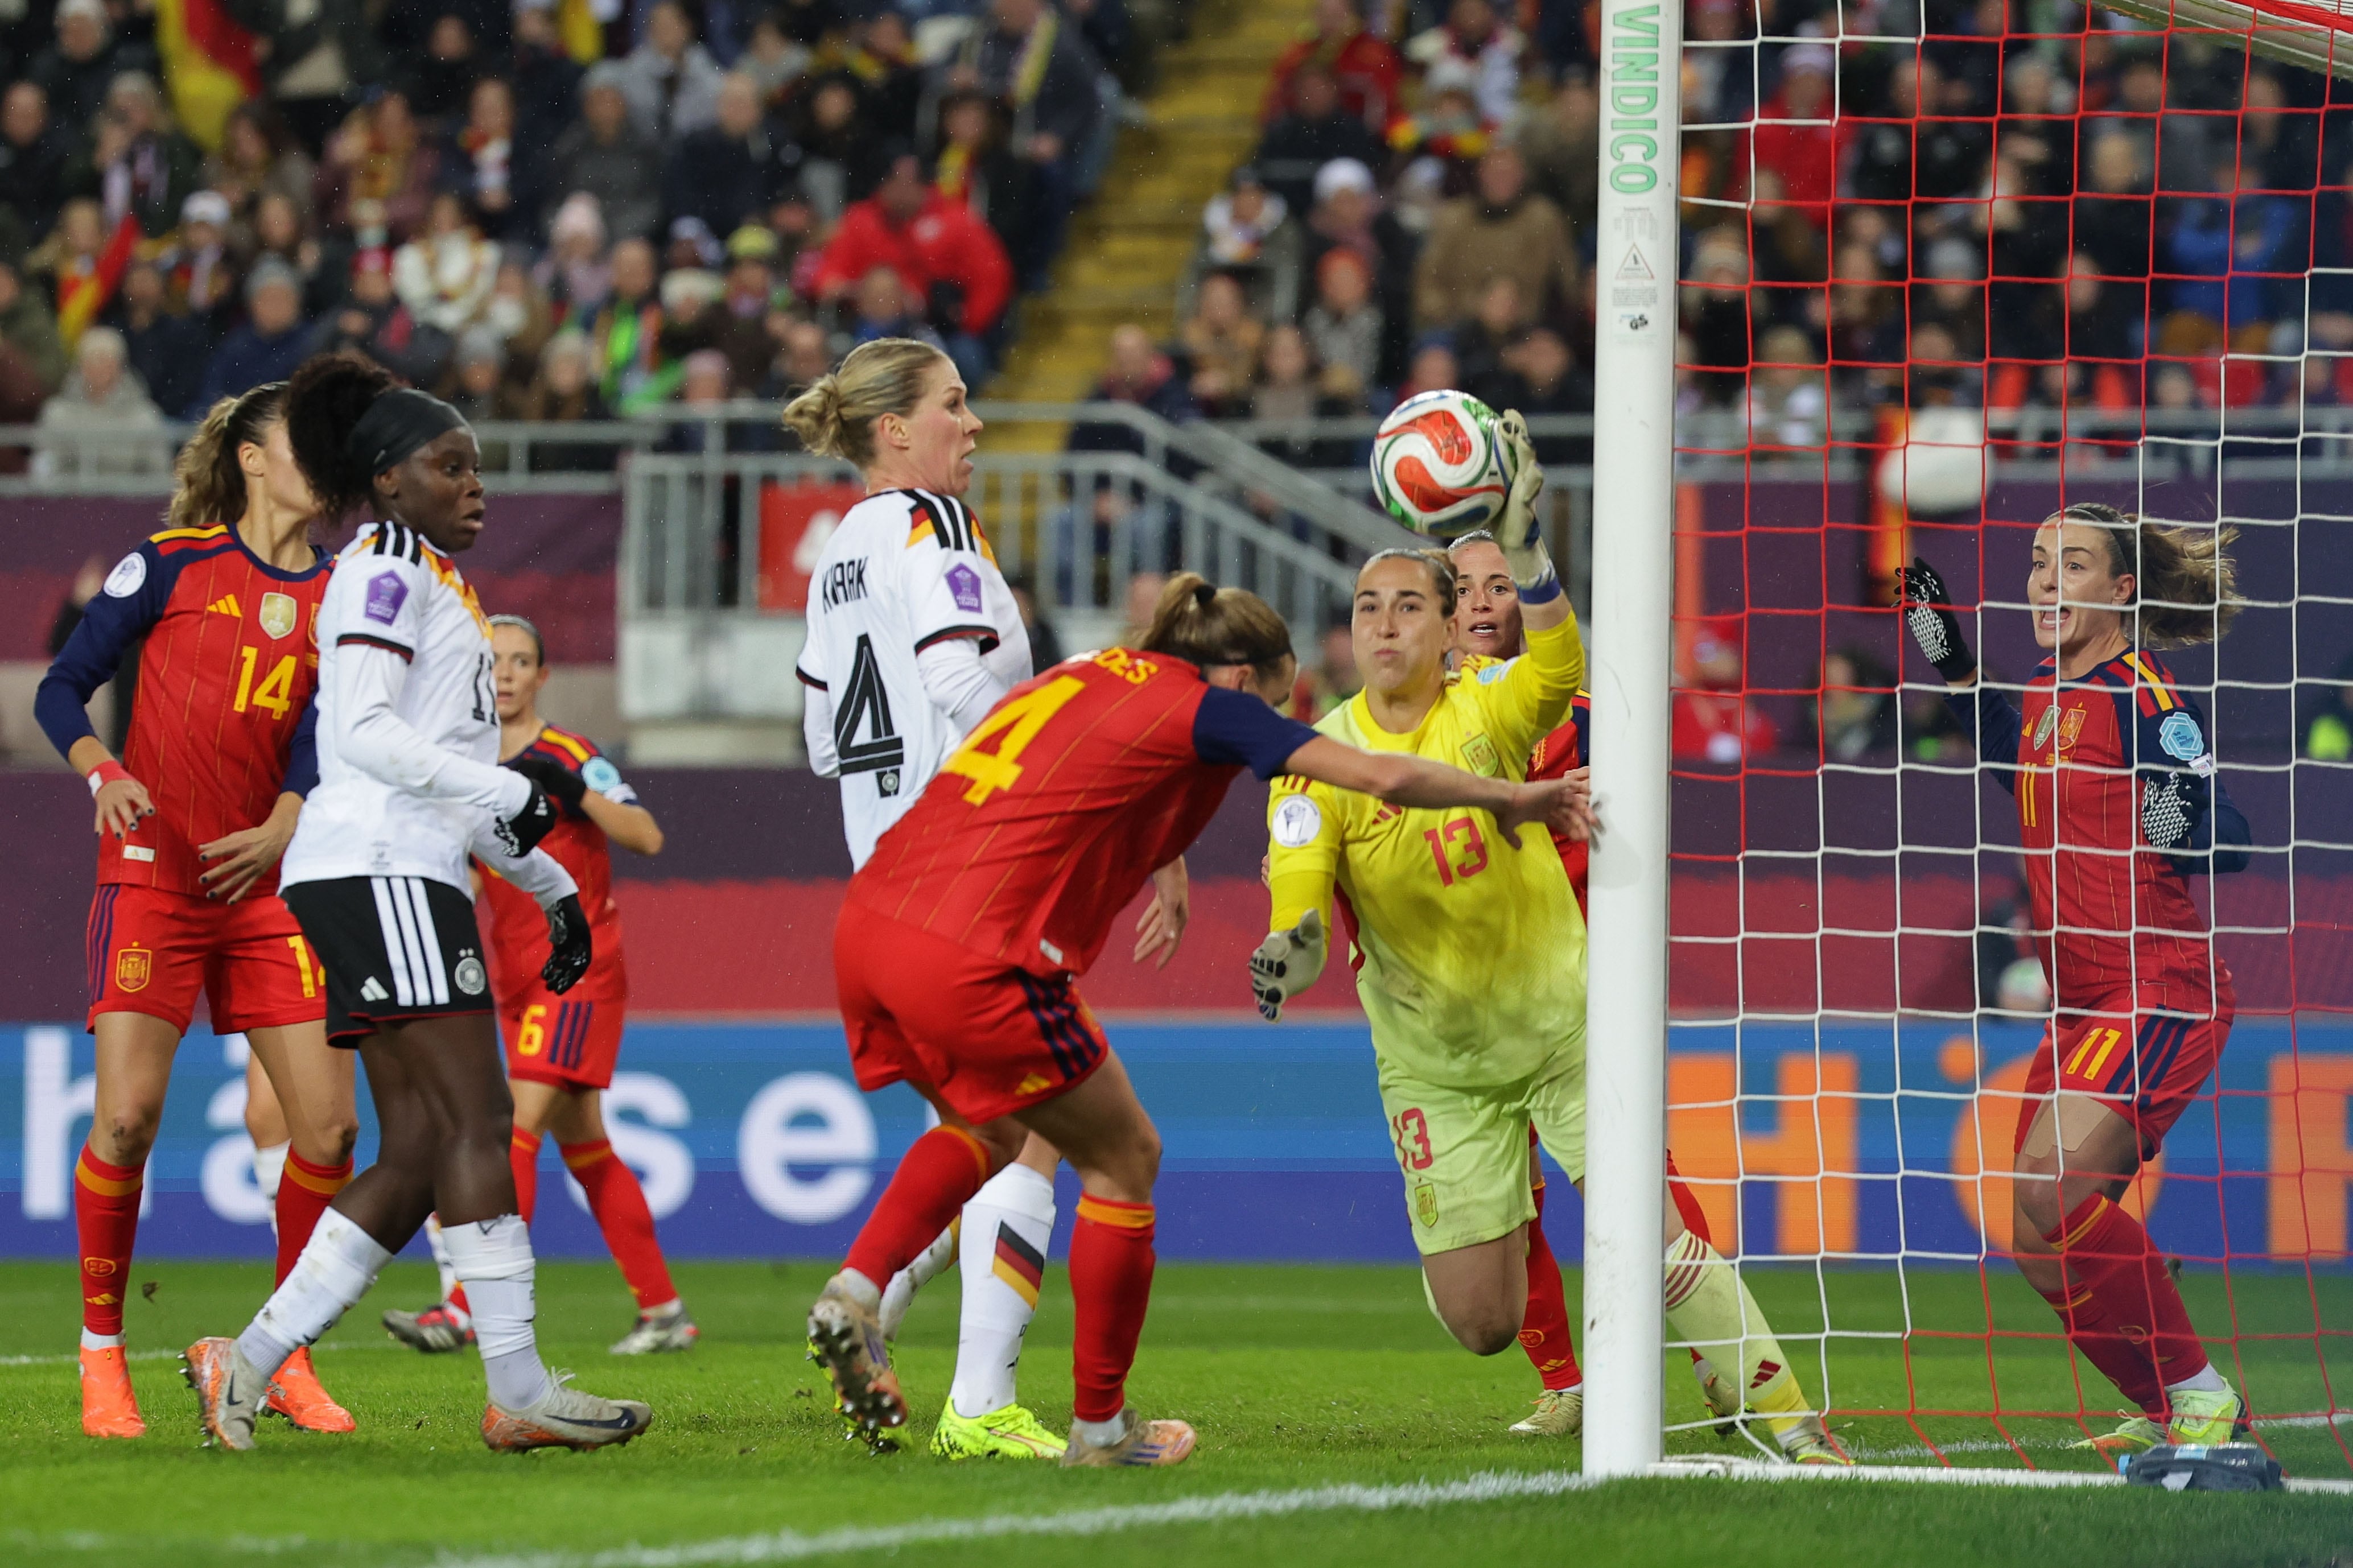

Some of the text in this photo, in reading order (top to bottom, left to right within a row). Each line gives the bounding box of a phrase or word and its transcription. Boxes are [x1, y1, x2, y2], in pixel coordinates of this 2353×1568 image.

[1610, 5, 1660, 193] VINDICO
[233, 645, 297, 720] 14
[835, 633, 904, 798] 4
[941, 674, 1086, 807] 4
[2022, 762, 2037, 827] 11
[1424, 818, 1488, 888] 13
[287, 935, 326, 998] 1
[517, 1004, 547, 1057] 6
[2066, 1028, 2122, 1081] 11
[1393, 1108, 1433, 1173] 13
